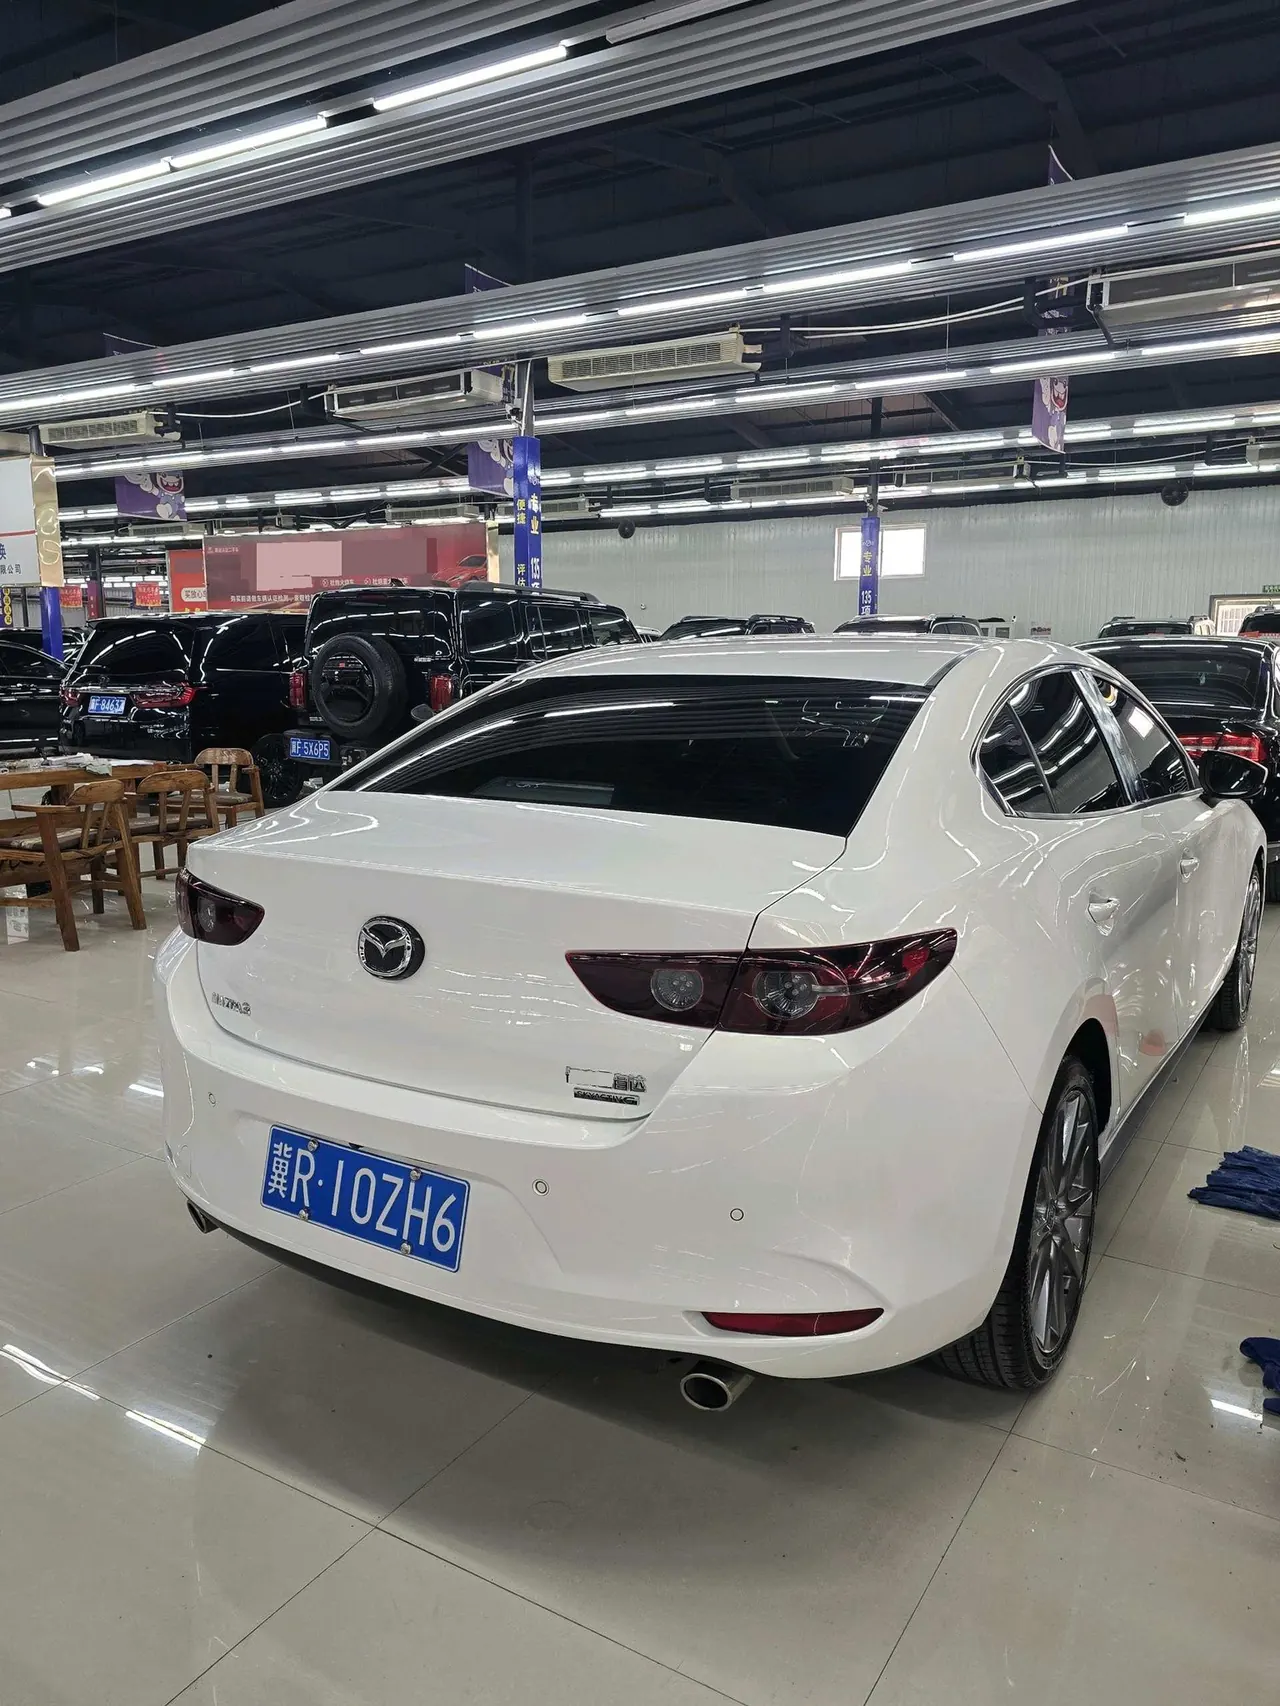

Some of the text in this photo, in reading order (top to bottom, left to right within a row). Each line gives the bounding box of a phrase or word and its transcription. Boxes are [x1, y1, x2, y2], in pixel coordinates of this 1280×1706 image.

[516, 499, 526, 525] 便捷
[862, 550, 873, 577] 专业
[267, 1140, 457, 1252] 冀R·10ZH6
